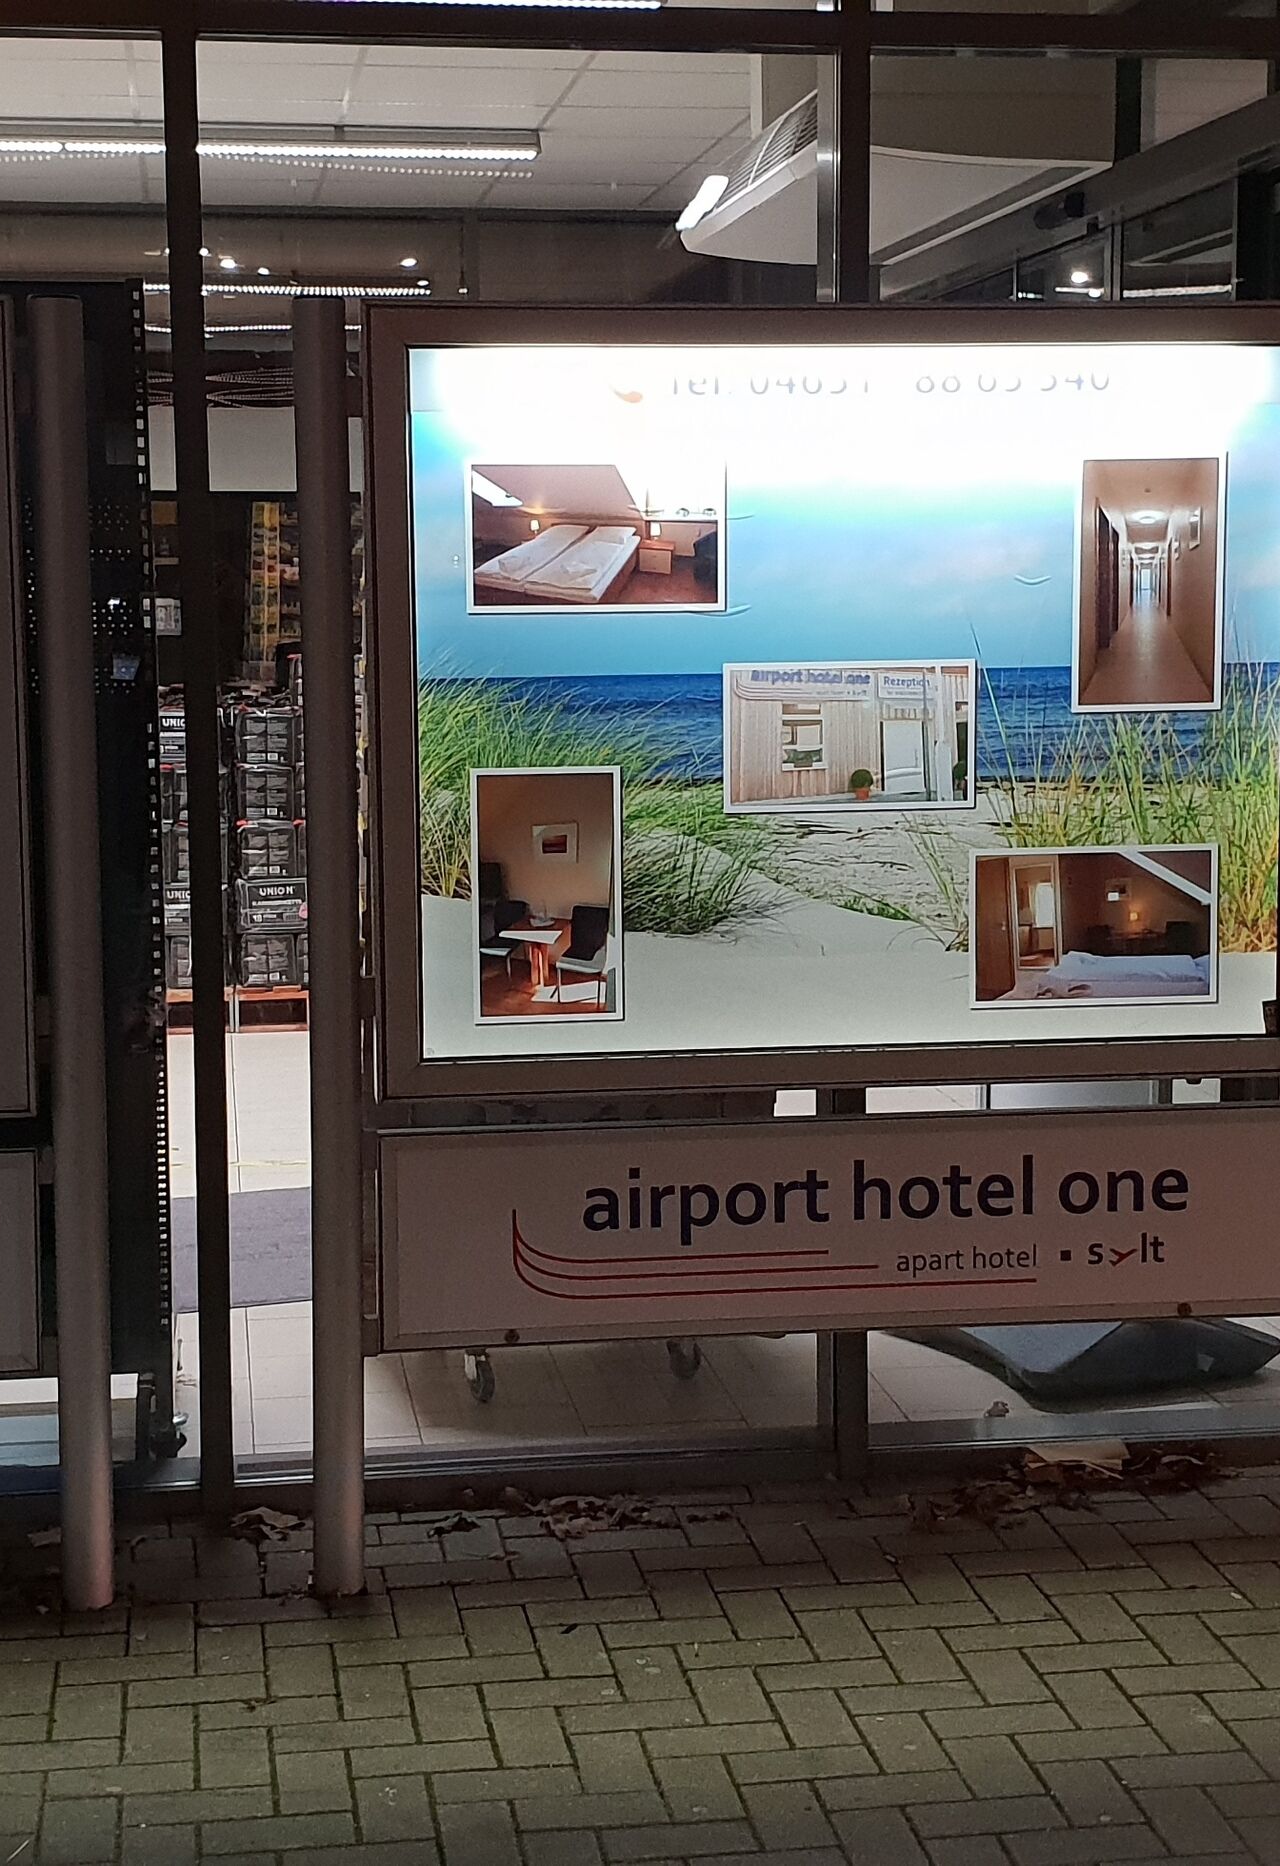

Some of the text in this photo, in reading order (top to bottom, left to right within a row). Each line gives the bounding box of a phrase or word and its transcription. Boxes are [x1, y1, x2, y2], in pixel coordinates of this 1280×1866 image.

[751, 668, 871, 686] airport hotel one
[883, 675, 930, 689] Rezeption
[258, 885, 294, 897] UNION
[582, 1154, 1189, 1247] airport hotel one
[896, 1232, 1165, 1278] apart hotel sylt
